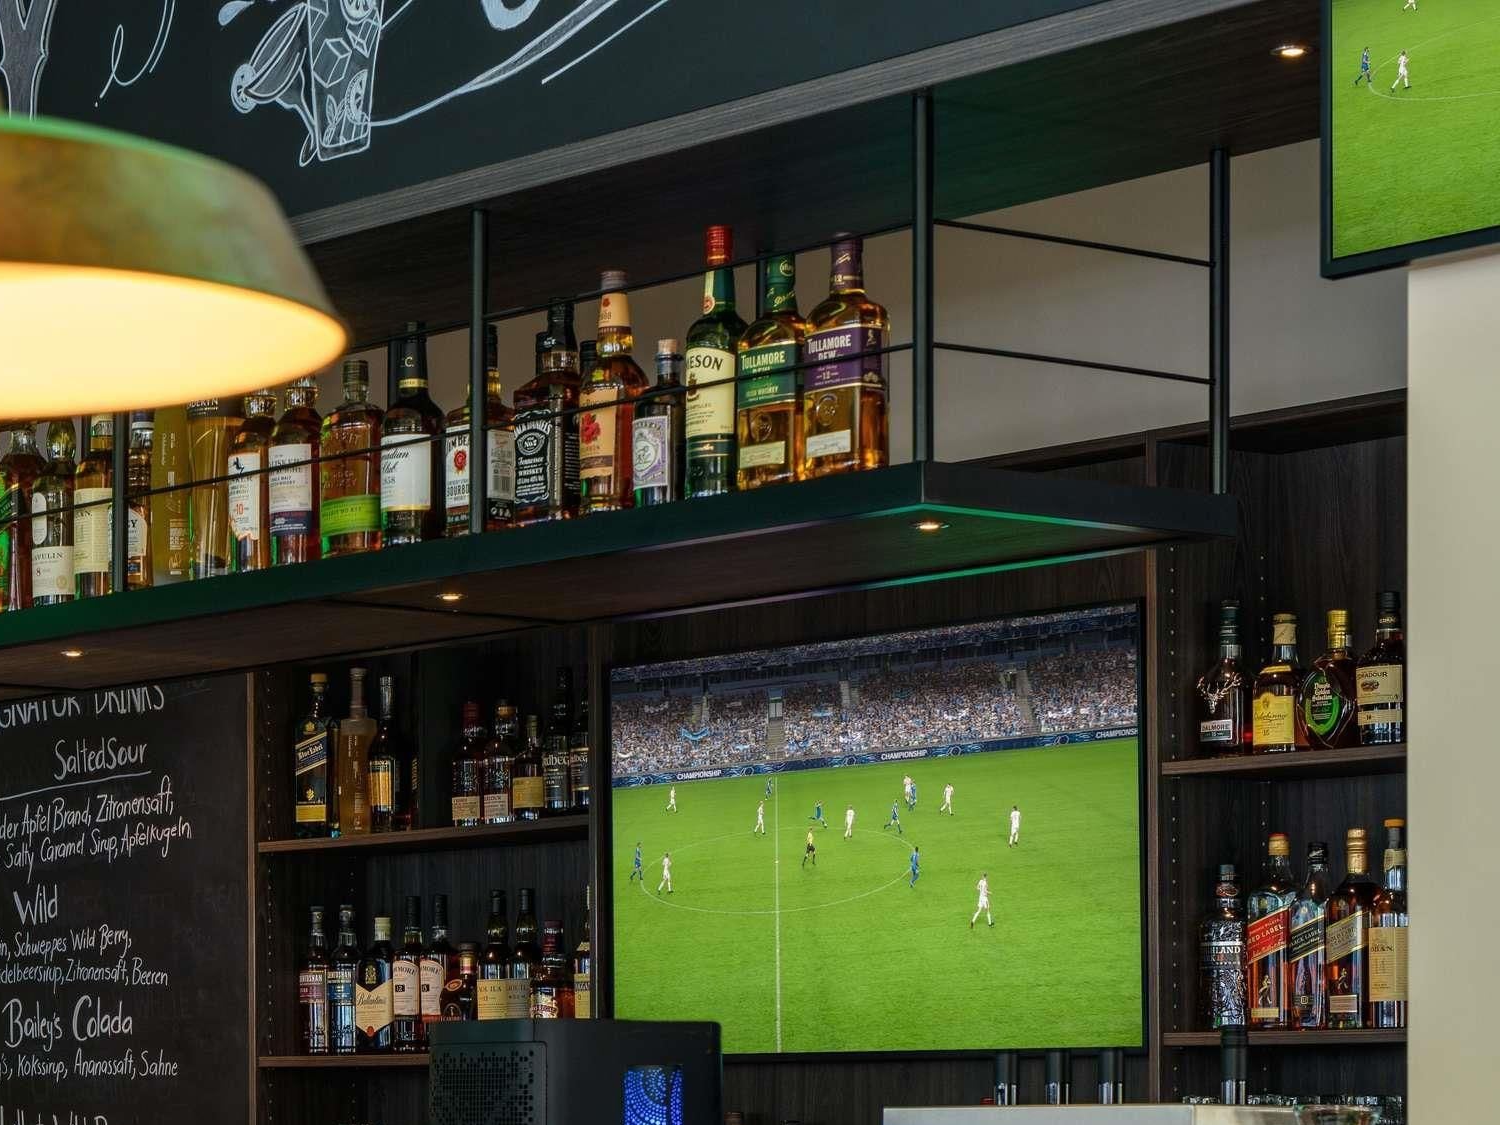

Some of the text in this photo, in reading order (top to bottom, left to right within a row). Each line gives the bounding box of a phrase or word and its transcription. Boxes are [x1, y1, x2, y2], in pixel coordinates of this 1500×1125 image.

[807, 334, 852, 354] TULLAMORE
[741, 350, 786, 371] TULLAMORE
[880, 749, 928, 761] CHAMPIONSHIP
[676, 769, 722, 781] CHAMPIONSHIP
[21, 803, 51, 847] Apfel
[52, 797, 91, 834] Brand,
[96, 774, 174, 823] Zitronensaft,
[5, 842, 34, 884] Salty
[40, 832, 85, 863] Caramel
[90, 828, 118, 863] Sirup,
[12, 883, 59, 926] Wild
[13, 931, 67, 964] Schweppes
[69, 927, 95, 951] Wild
[98, 923, 133, 959] Berry,
[1261, 924, 1284, 938] LABEL
[131, 957, 168, 987] Beeren
[2, 995, 133, 1051] Bailey's Colada
[138, 1049, 179, 1077] Sahne
